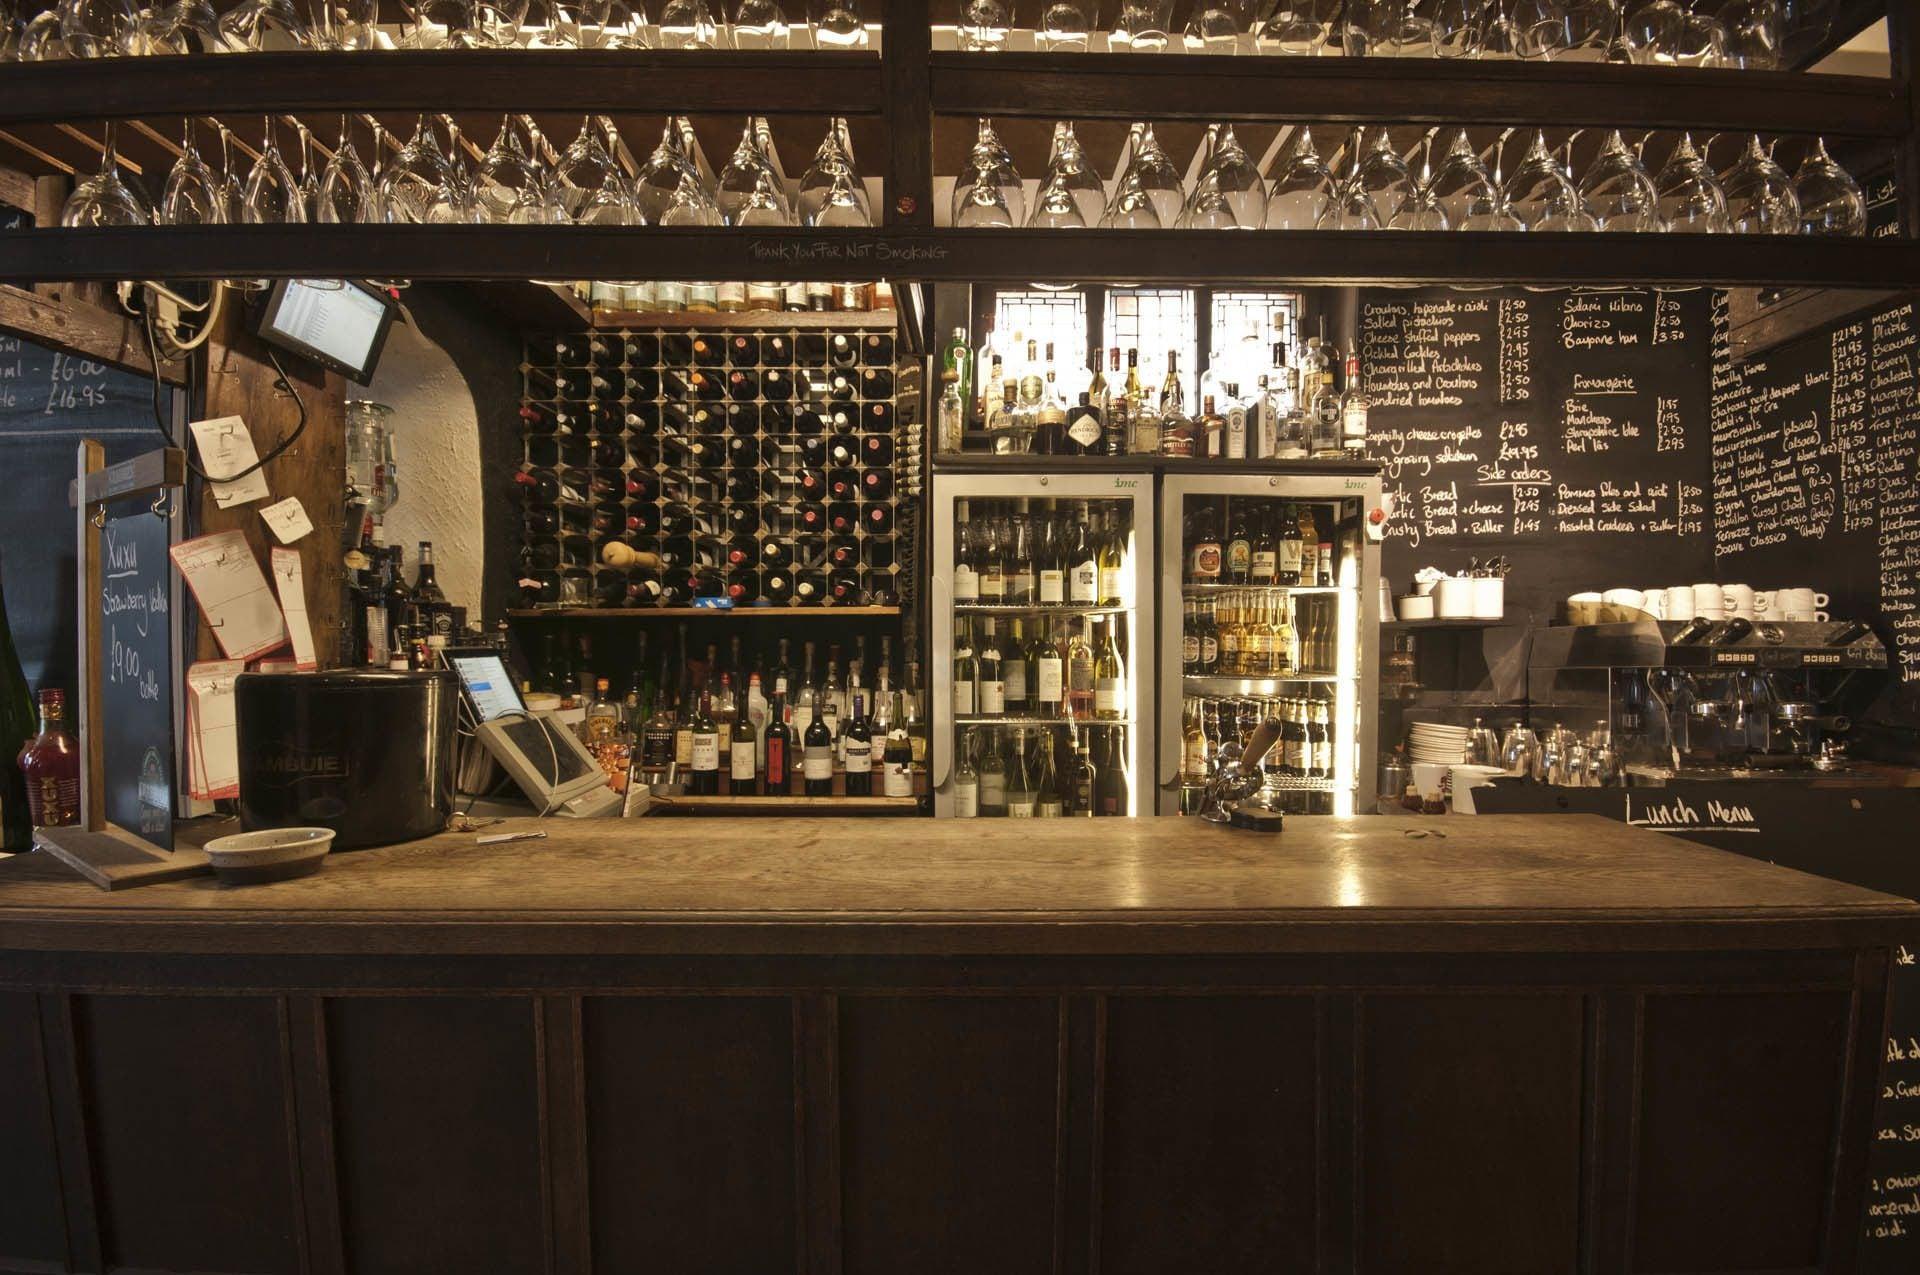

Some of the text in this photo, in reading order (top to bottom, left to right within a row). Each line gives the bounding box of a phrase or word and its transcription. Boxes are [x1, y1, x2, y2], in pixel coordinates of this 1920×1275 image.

[1563, 314, 1611, 331] Chorizo
[1412, 374, 1432, 390] and
[1565, 398, 1589, 414] Brie
[1476, 461, 1552, 482] Side orders
[1420, 481, 1459, 504] Bread
[1424, 501, 1458, 518] Bread
[1424, 519, 1458, 537] Bread
[106, 528, 138, 570] Xuxu
[1626, 792, 1755, 826] Lunch Menu
